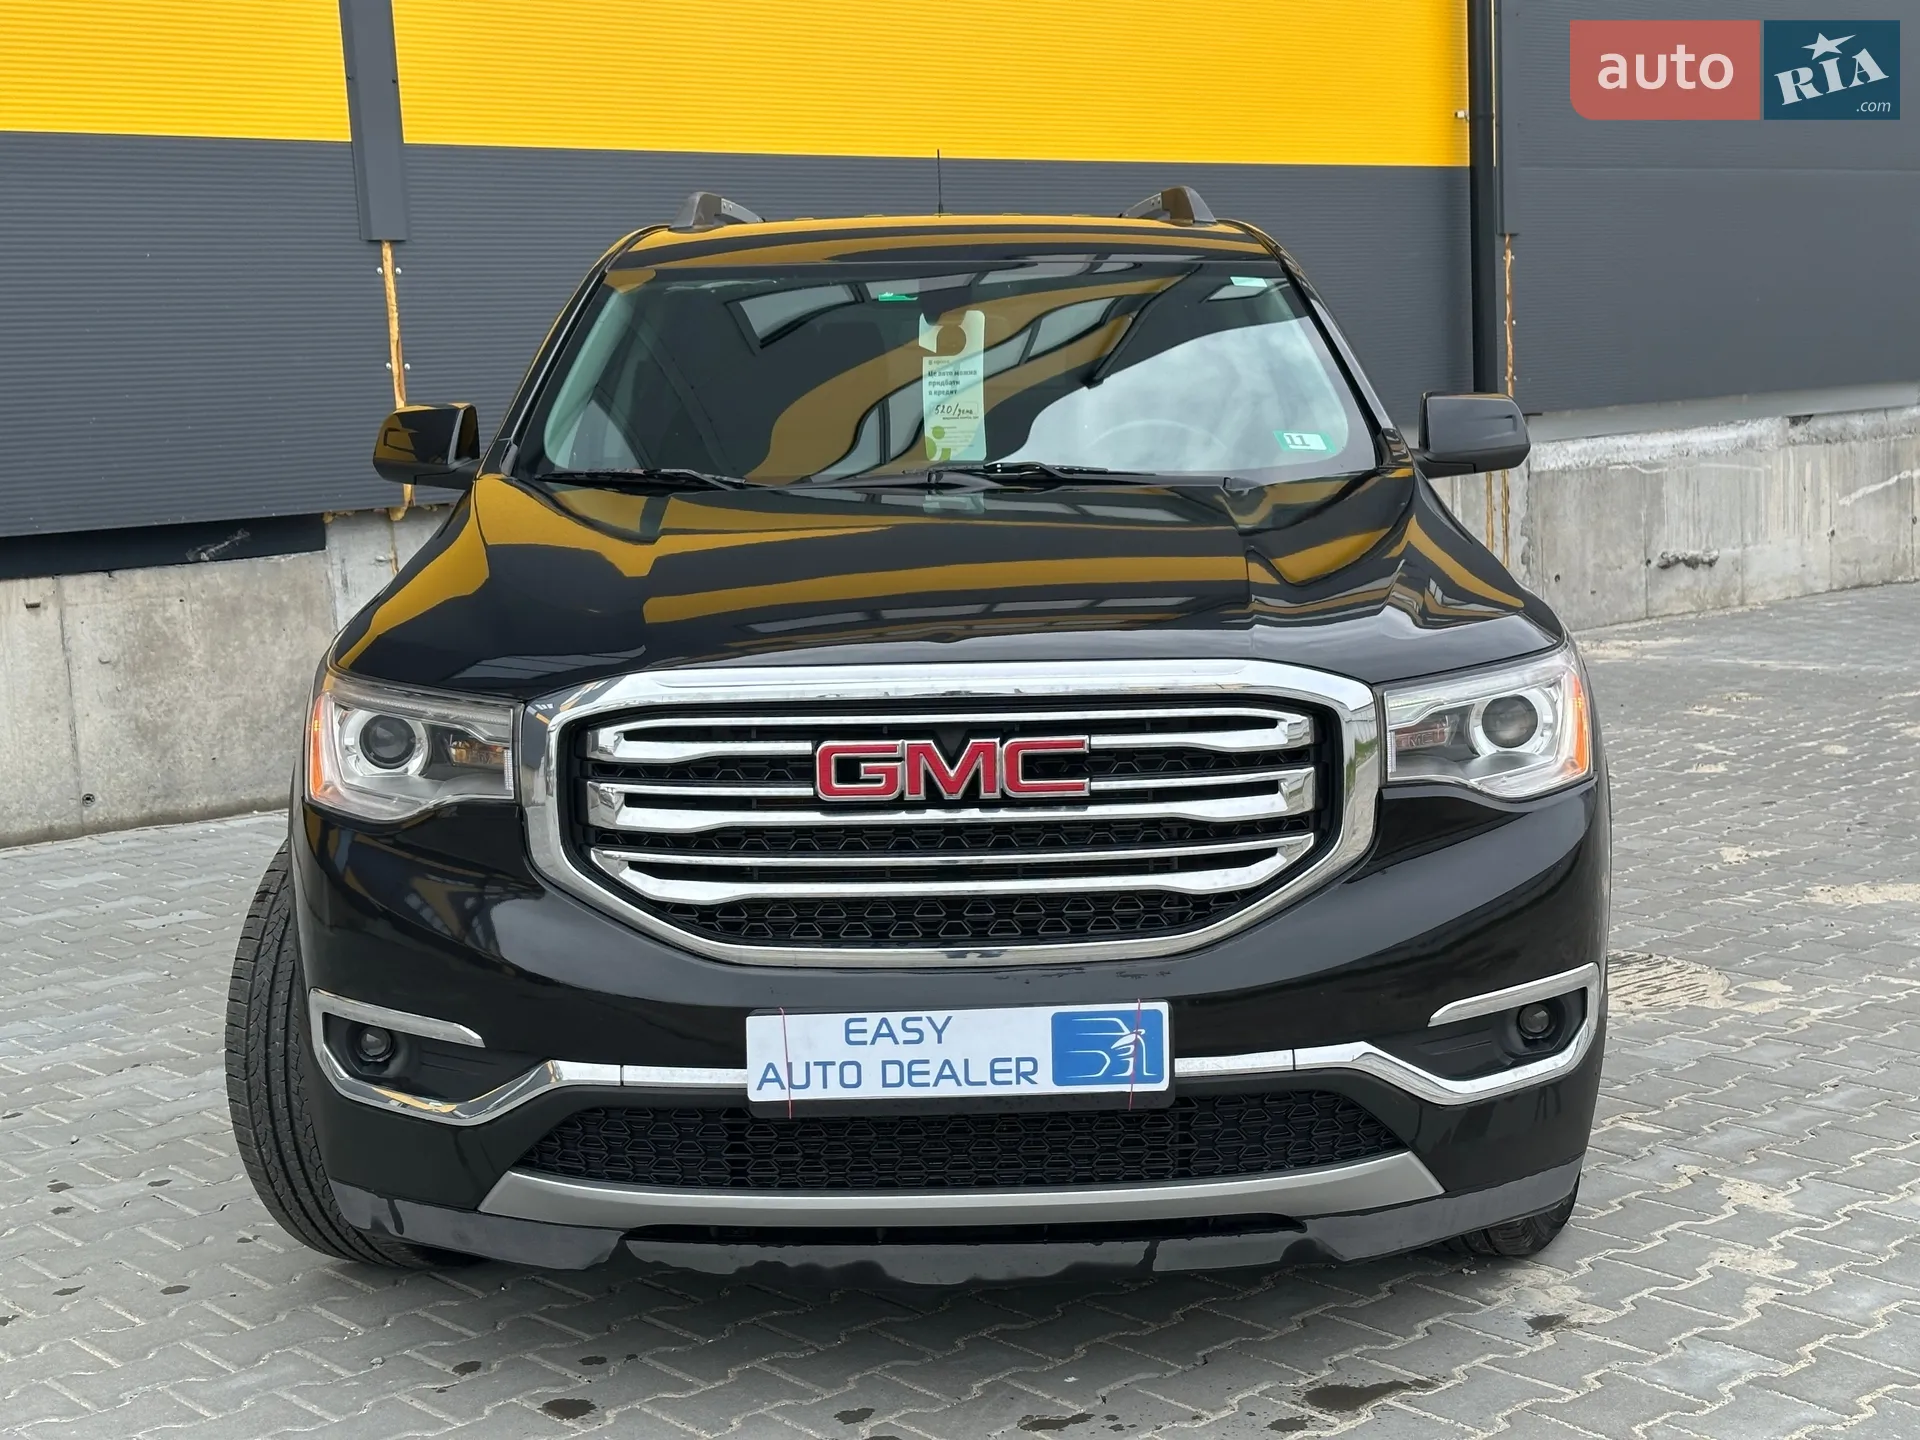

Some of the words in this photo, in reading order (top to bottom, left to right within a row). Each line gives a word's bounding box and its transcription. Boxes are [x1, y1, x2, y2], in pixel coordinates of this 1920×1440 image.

[816, 735, 1090, 801] GMC
[844, 1016, 953, 1046] EASY
[757, 1060, 863, 1091] AUTO
[881, 1056, 1039, 1089] DEALER
